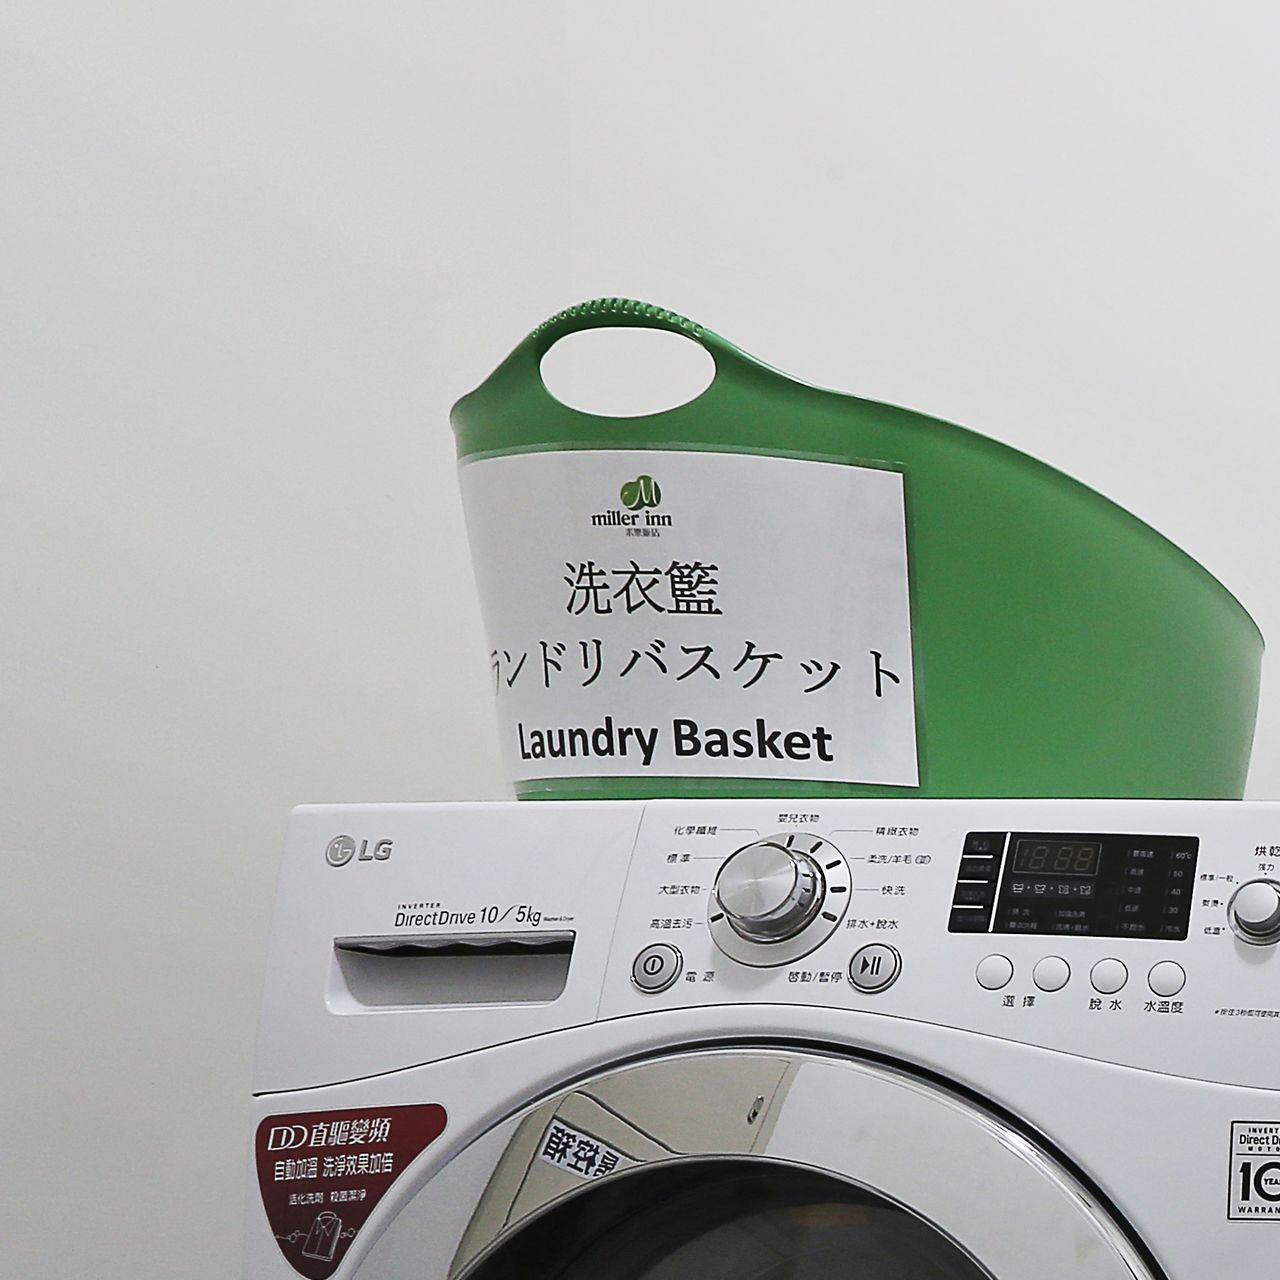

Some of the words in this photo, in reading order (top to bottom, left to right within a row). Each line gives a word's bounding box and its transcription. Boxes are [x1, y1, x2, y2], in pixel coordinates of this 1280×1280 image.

[591, 510, 640, 527] miller
[645, 511, 672, 527] inn
[563, 560, 723, 616] 洗衣籃
[518, 716, 659, 766] Laundry
[673, 719, 834, 763] Basket
[358, 839, 392, 861] LG
[1239, 1134, 1270, 1146] Direct
[274, 1157, 317, 1182] 自動加溫
[322, 1152, 394, 1177] 洗淨效果加倍
